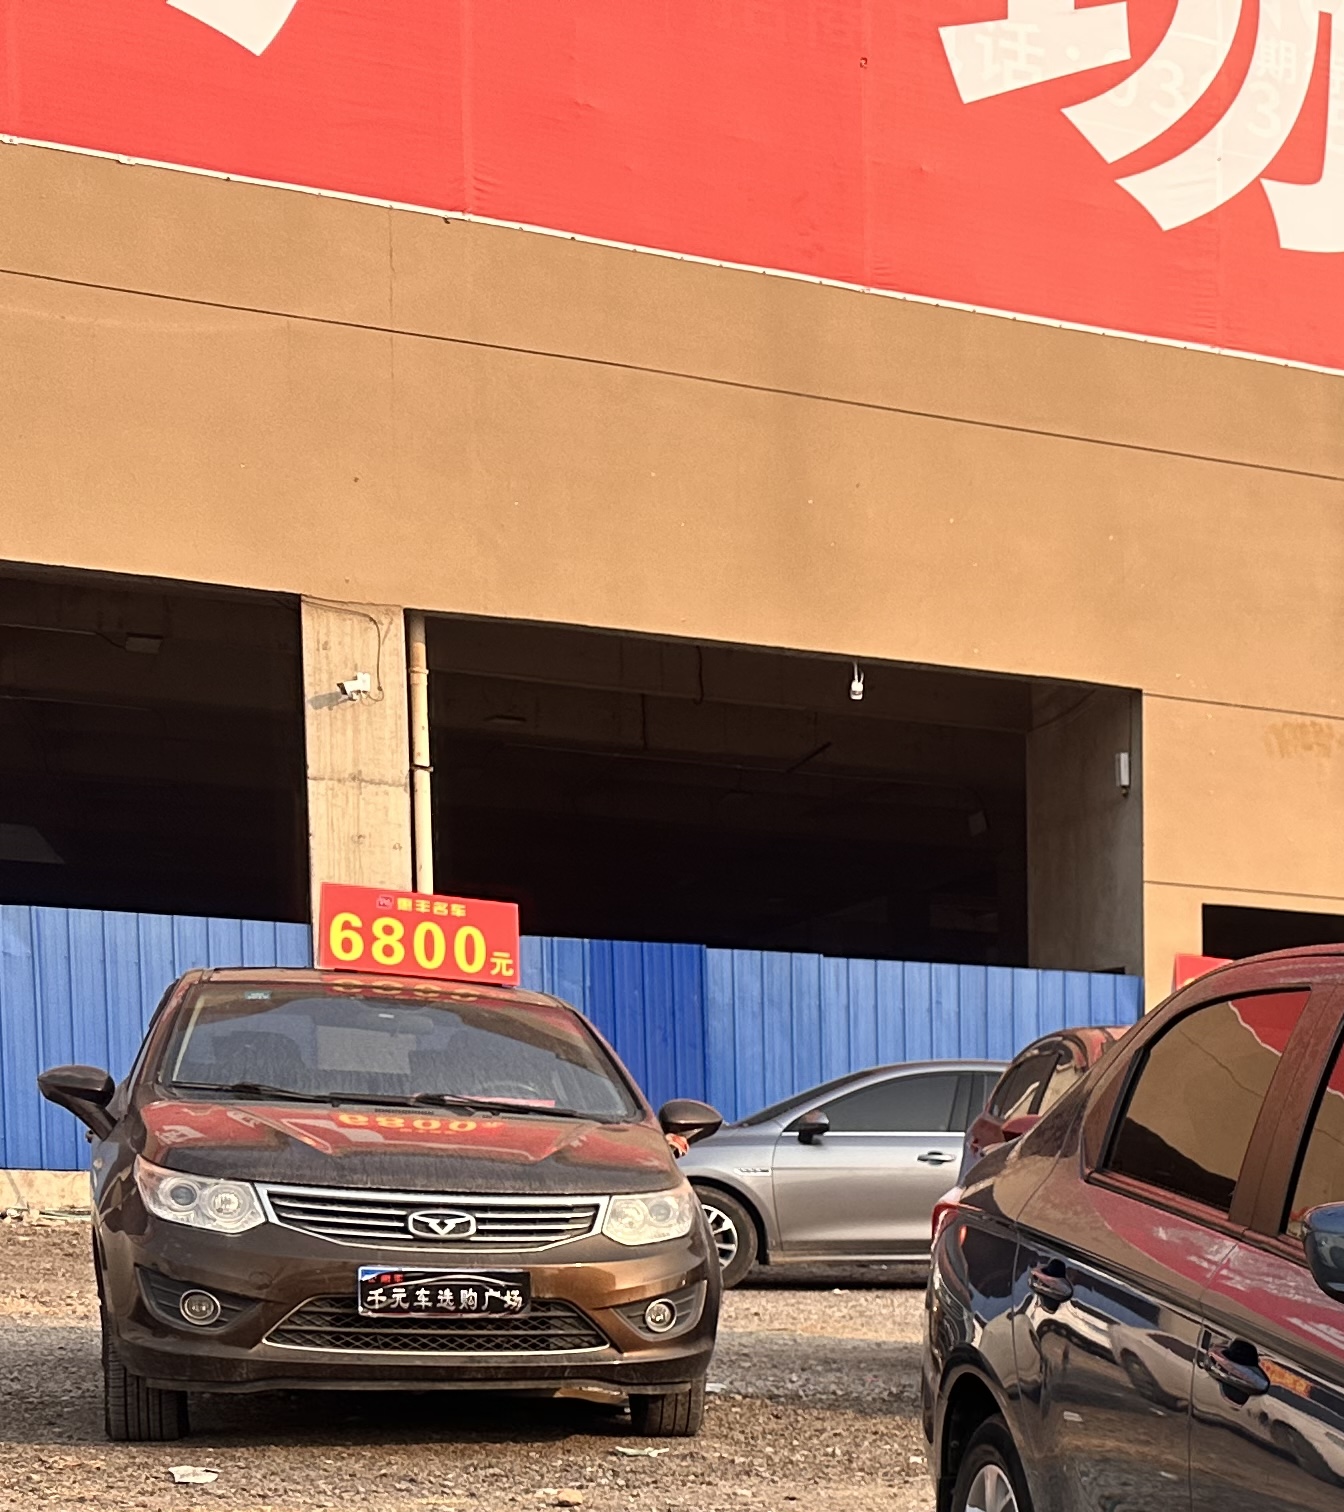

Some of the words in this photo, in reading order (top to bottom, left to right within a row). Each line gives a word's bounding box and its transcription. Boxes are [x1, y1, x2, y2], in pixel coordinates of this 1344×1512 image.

[329, 911, 515, 977] 6800元
[366, 1286, 524, 1312] 千元车选购广场
